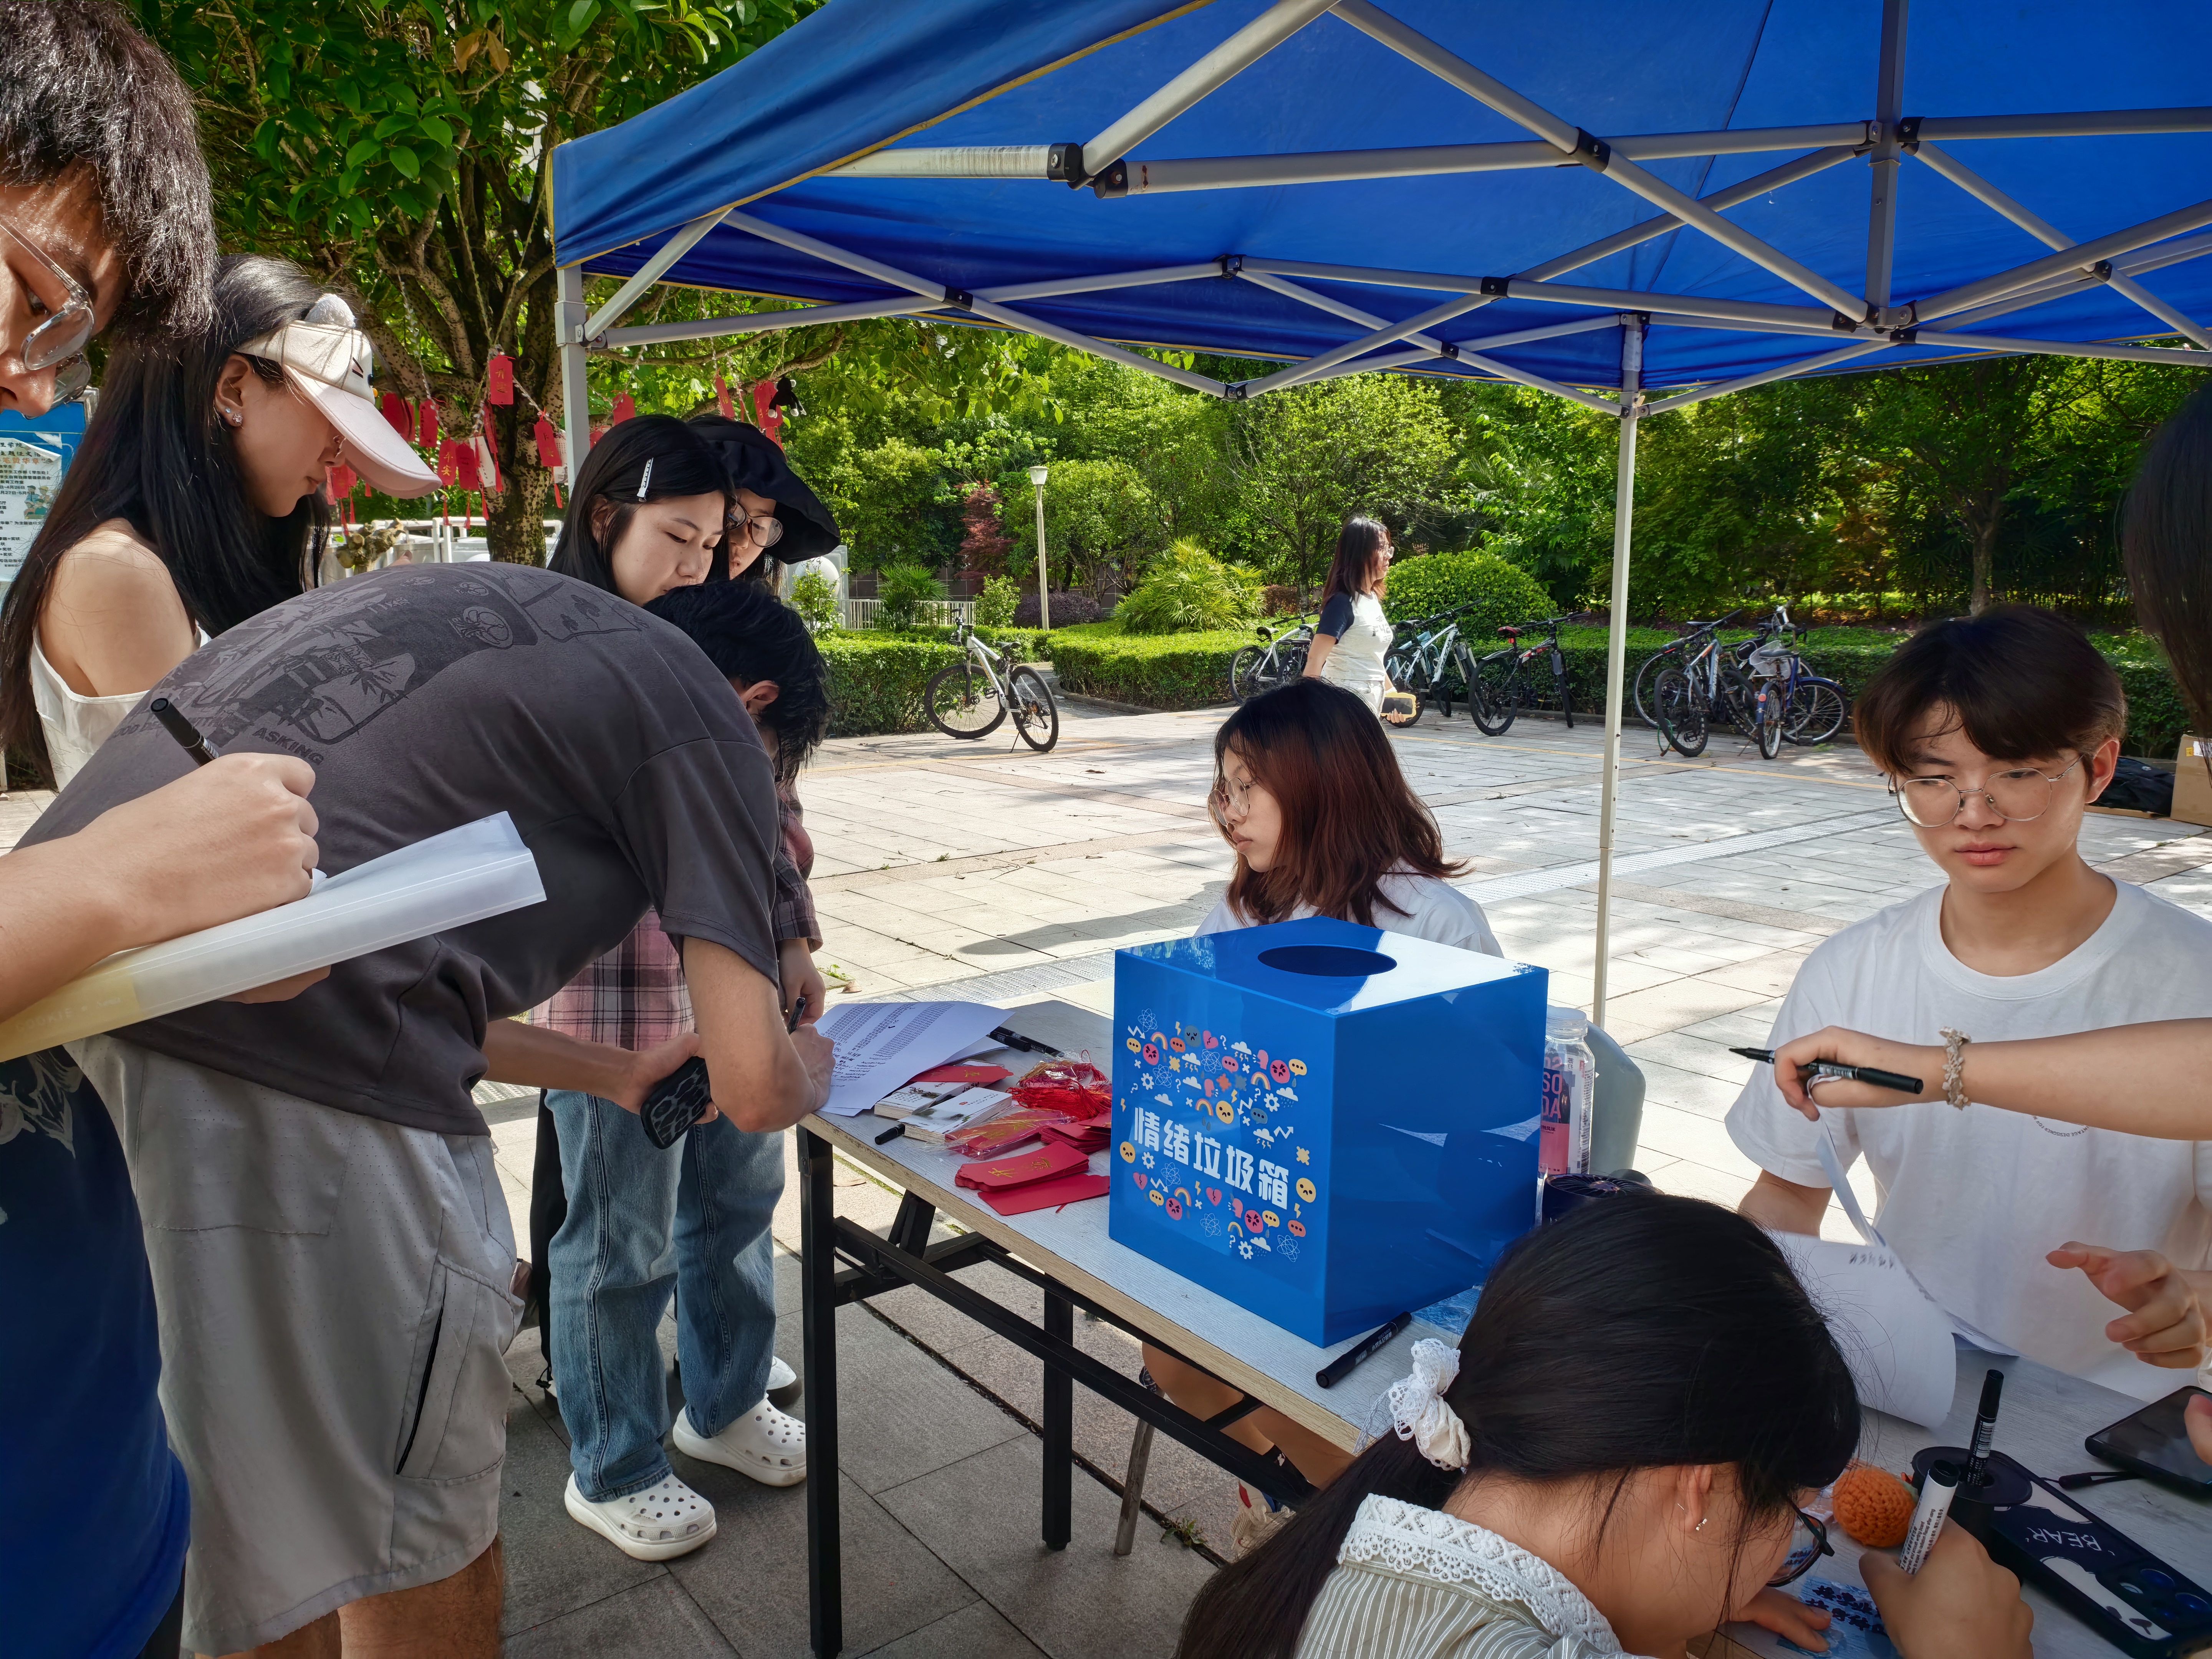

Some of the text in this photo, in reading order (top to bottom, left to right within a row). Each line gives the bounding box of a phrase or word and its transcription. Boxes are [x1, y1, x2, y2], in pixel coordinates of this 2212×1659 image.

[252, 727, 324, 766] ASKING
[1134, 1107, 1289, 1210] 情绪垃圾箱
